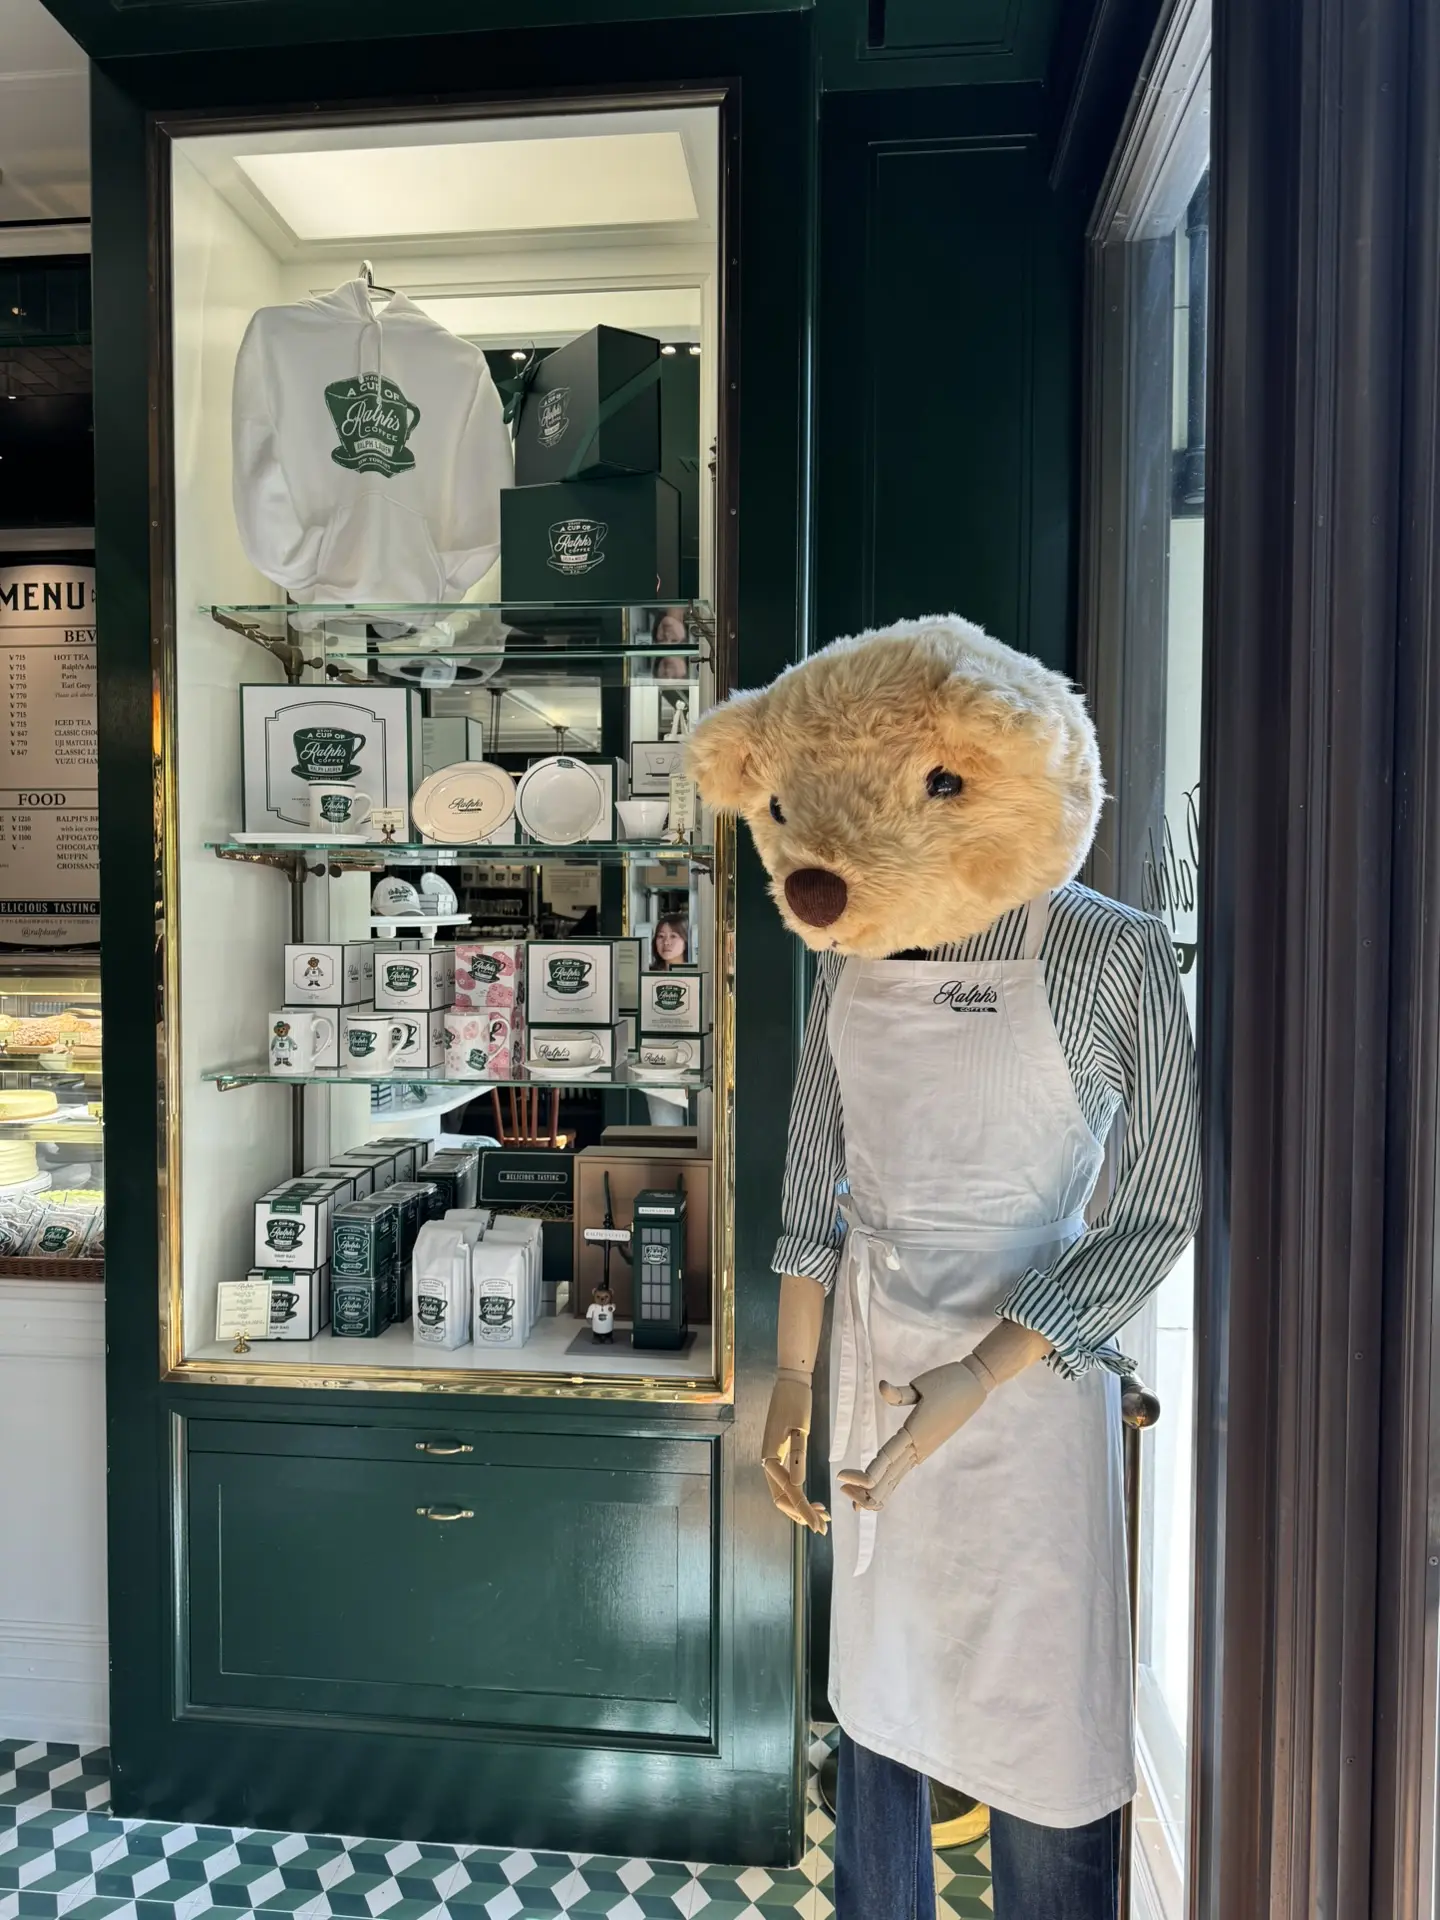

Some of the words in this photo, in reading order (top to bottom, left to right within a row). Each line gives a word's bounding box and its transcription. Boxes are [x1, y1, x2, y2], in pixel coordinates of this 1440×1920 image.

[346, 387, 357, 397] A
[384, 389, 400, 401] OF
[341, 398, 400, 438] Ralph's
[364, 426, 398, 442] COFFEE
[554, 534, 592, 556] Ralph's
[0, 582, 85, 611] MENU
[300, 741, 347, 766] Ralph's
[18, 793, 66, 806] FOOD
[448, 797, 484, 811] Ralph's
[54, 903, 96, 913] TASTING
[933, 980, 997, 1008] Ralph's
